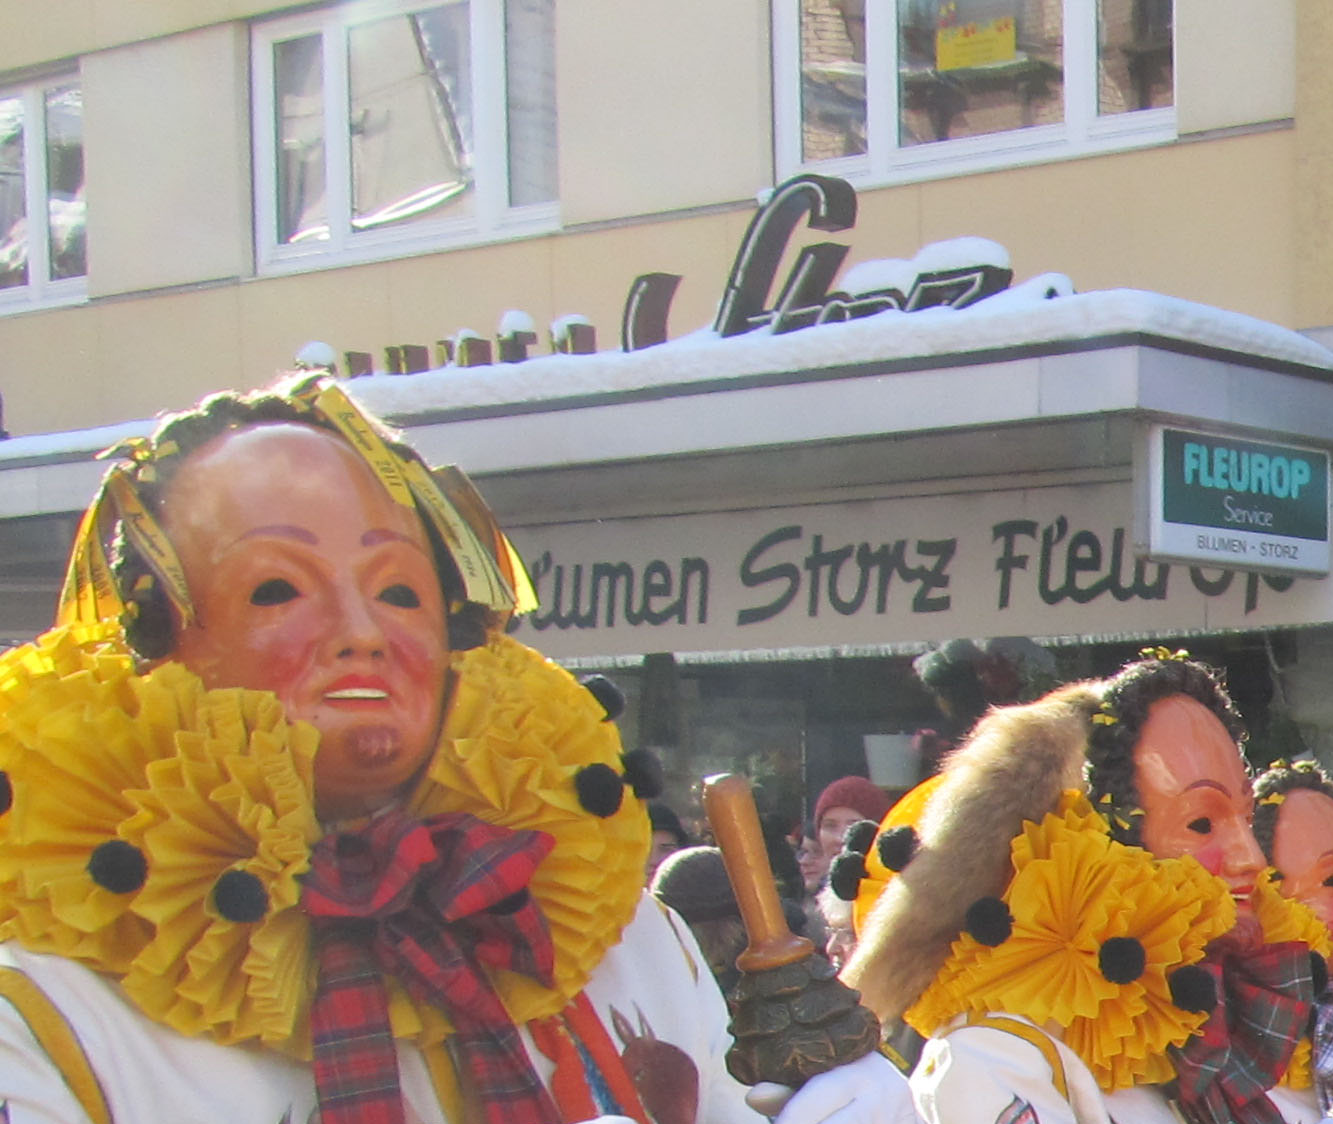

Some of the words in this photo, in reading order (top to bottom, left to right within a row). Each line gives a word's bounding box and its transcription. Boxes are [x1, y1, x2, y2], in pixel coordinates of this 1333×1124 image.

[1184, 442, 1311, 499] FLEUROP
[1223, 495, 1273, 527] Service
[1198, 535, 1248, 553] BLUMEN
[1260, 542, 1300, 560] STORZ
[505, 550, 709, 633] lumen
[737, 526, 956, 626] Storz
